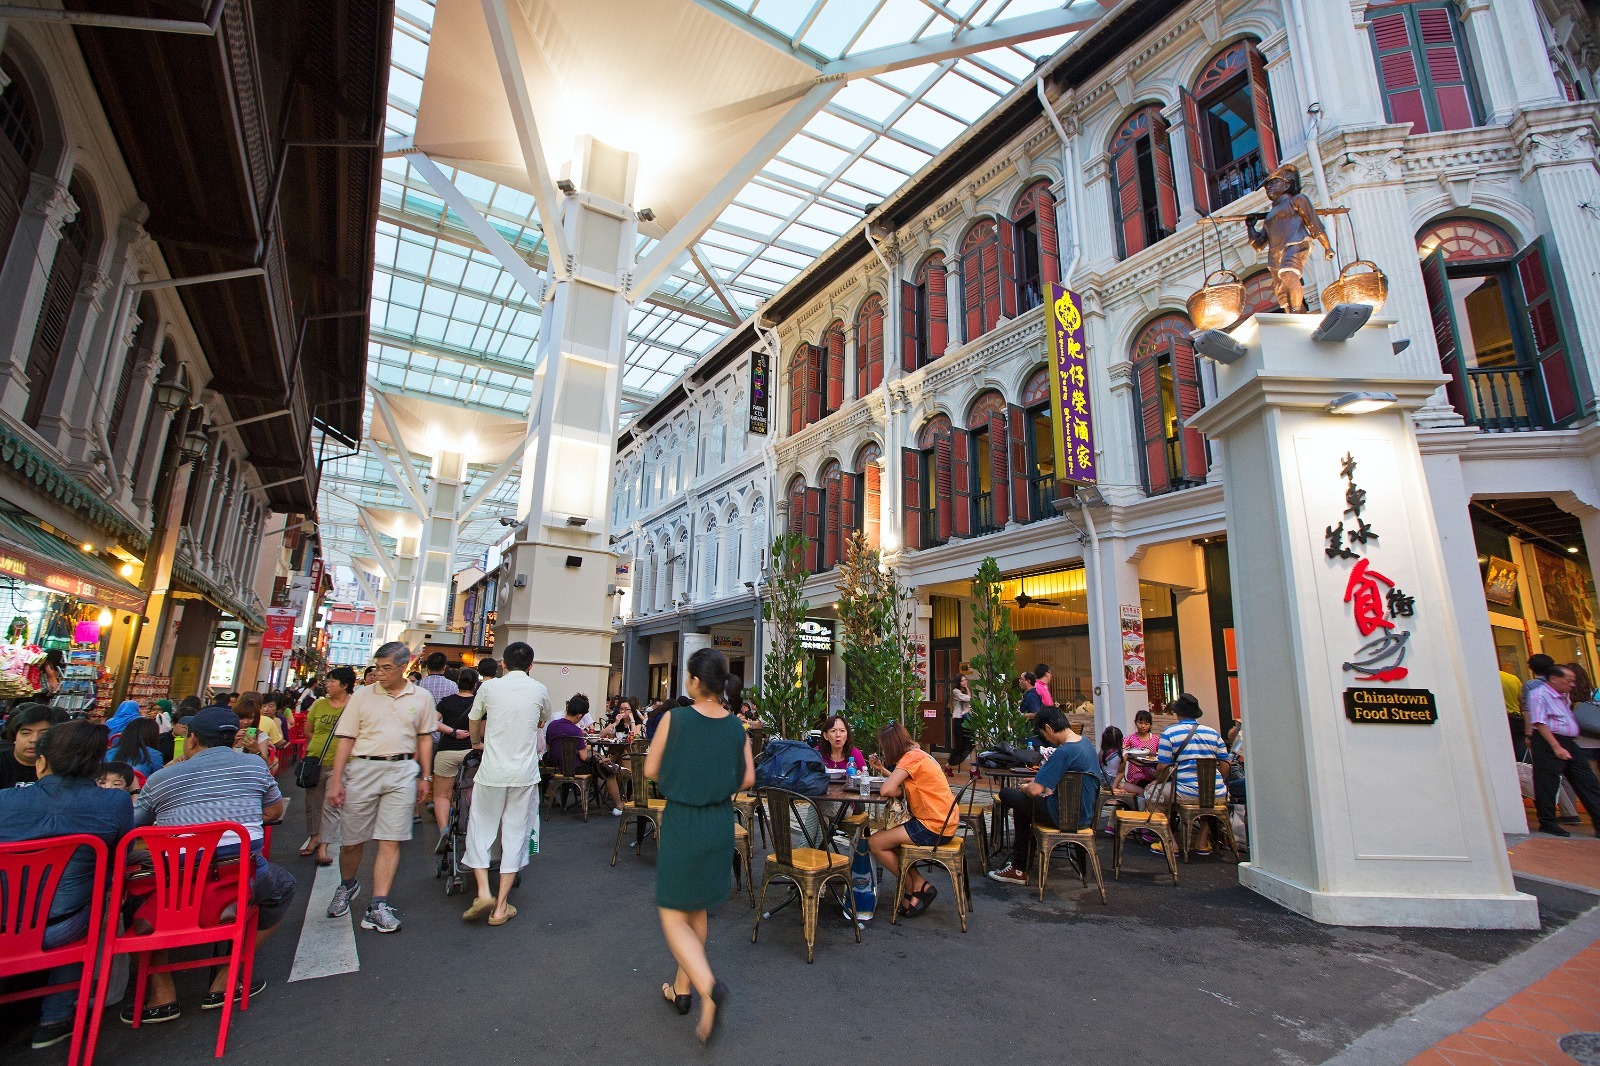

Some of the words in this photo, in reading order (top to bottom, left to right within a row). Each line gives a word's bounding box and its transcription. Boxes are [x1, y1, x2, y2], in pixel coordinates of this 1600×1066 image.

[1353, 691, 1429, 705] Chinatown
[1354, 707, 1389, 720] Food
[1391, 707, 1432, 721] Street
